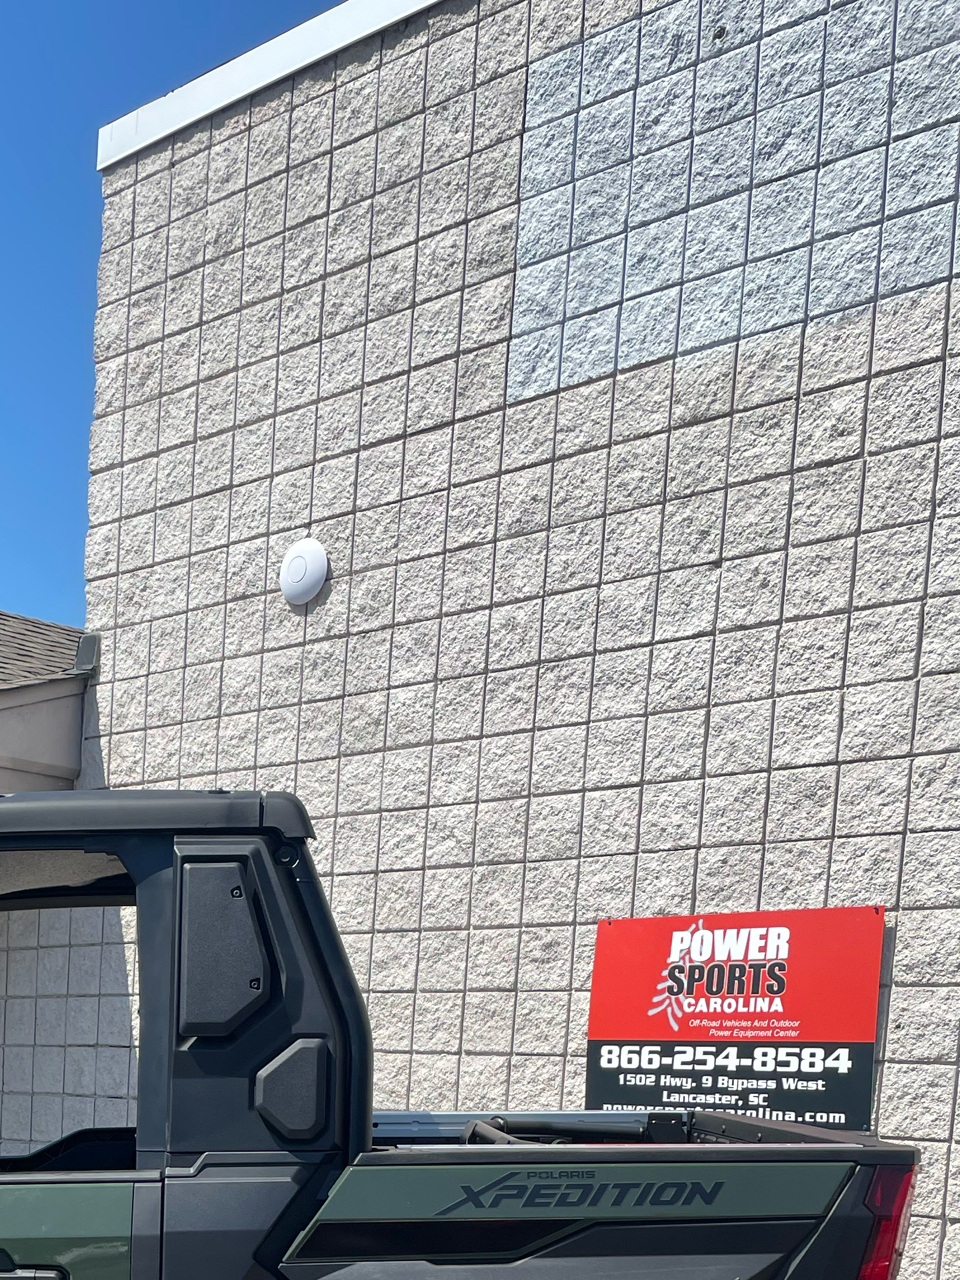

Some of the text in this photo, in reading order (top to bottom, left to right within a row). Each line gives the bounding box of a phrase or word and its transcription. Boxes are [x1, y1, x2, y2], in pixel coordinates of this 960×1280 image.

[670, 927, 790, 962] POWER
[666, 961, 788, 996] SPORTS
[683, 997, 784, 1013] CAROLINA
[689, 1018, 800, 1027] Off-Road Vehicles And Outdoor
[709, 1029, 800, 1038] Power Equipment Center
[600, 1045, 852, 1074] 866-254-8584
[618, 1073, 826, 1091] 1502 Hwy. 9 Bypass West
[662, 1090, 768, 1107] Lancaster, SC
[602, 1103, 846, 1124] powerrolina.com
[527, 1170, 596, 1180] POLARIS
[431, 1170, 726, 1217] XPEDITION
